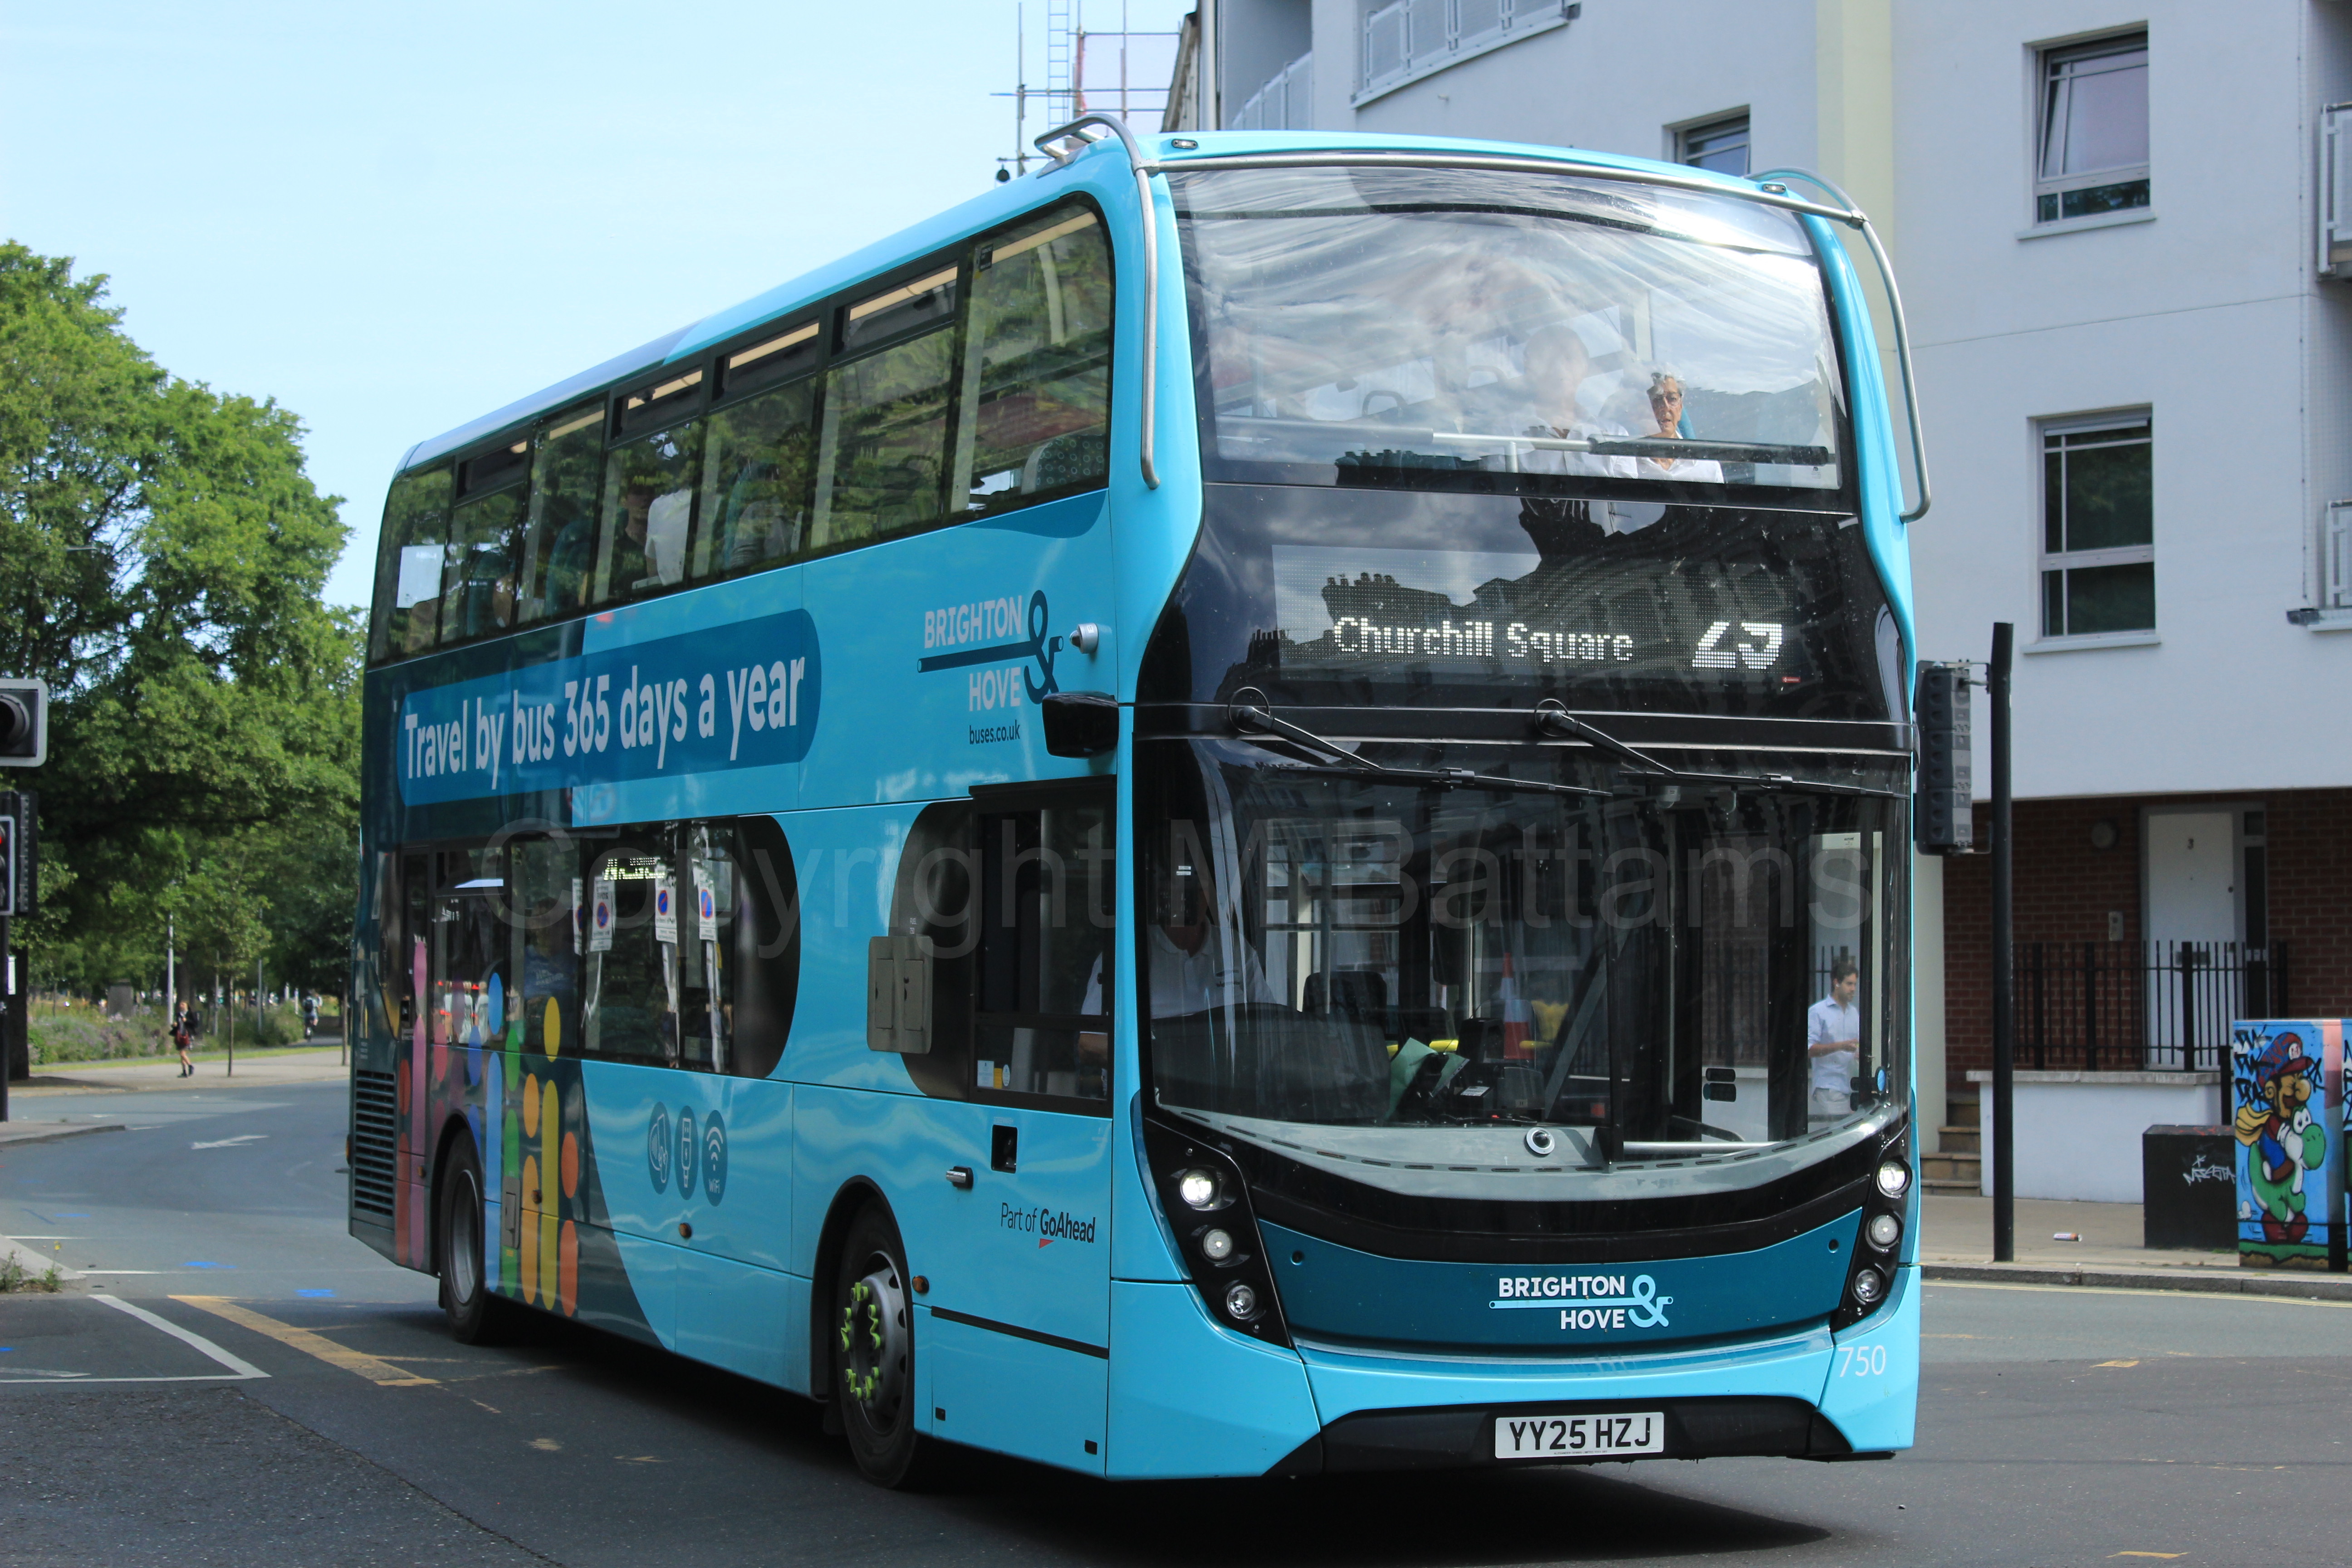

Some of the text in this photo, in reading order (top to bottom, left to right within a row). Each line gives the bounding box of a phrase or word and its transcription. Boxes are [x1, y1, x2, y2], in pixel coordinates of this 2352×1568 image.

[924, 595, 1022, 649] BRIGHTON
[1334, 617, 1633, 663] Churchill Square
[969, 666, 1020, 712] HOVE
[405, 657, 805, 790] Travel by bus 365 days a year
[970, 720, 1020, 745] buses.co.uk
[1001, 1202, 1096, 1243] Part of GoAhead
[1499, 1275, 1626, 1298] BRIGHTON
[1560, 1309, 1625, 1330] HOVE
[1838, 1345, 1886, 1377] 750
[1509, 1417, 1651, 1451] YY25 HZJ
